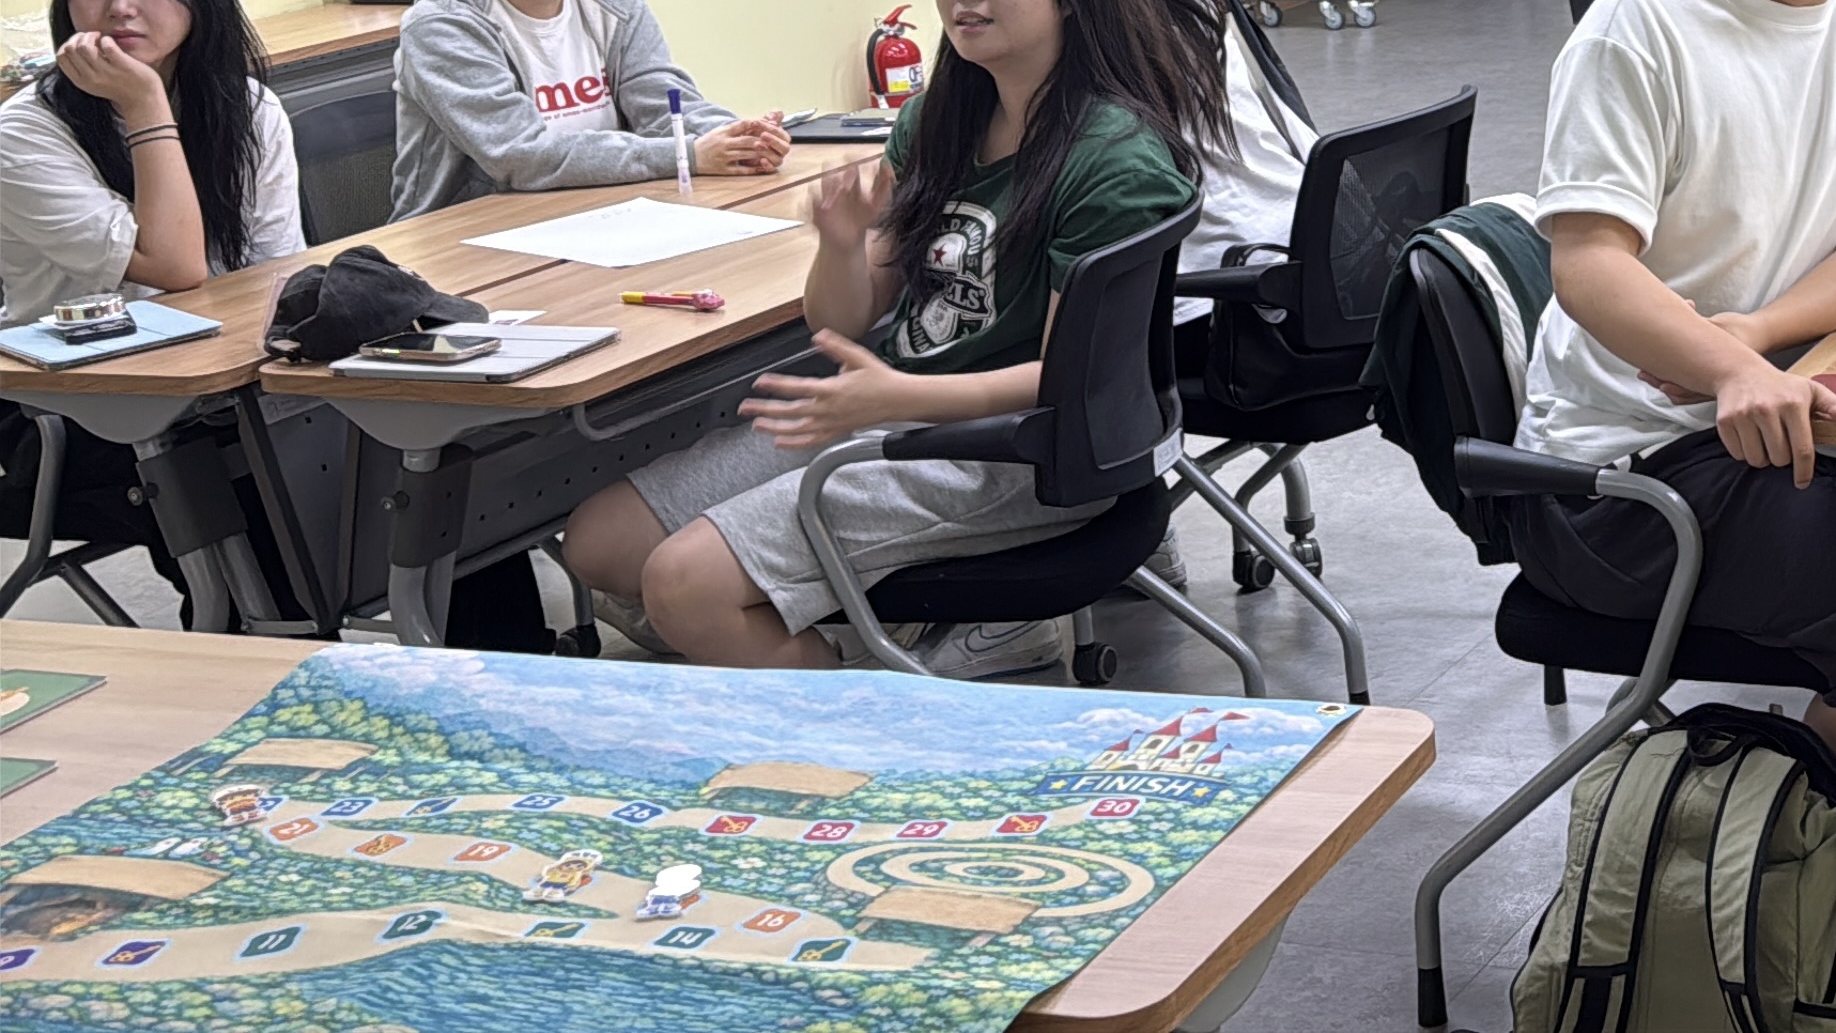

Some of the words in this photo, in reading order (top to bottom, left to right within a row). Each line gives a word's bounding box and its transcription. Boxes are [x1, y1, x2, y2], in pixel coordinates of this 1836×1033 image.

[1070, 774, 1196, 797] FINISH
[330, 800, 361, 813] 23
[521, 796, 551, 807] 25
[1096, 800, 1132, 814] 30
[626, 805, 656, 818] 26
[278, 822, 310, 835] 21
[811, 824, 846, 838] 28
[904, 823, 940, 836] 29
[467, 846, 499, 857] 19
[397, 915, 427, 932] 12
[756, 913, 785, 928] 16
[258, 934, 287, 950] 11
[671, 930, 702, 943] 14
